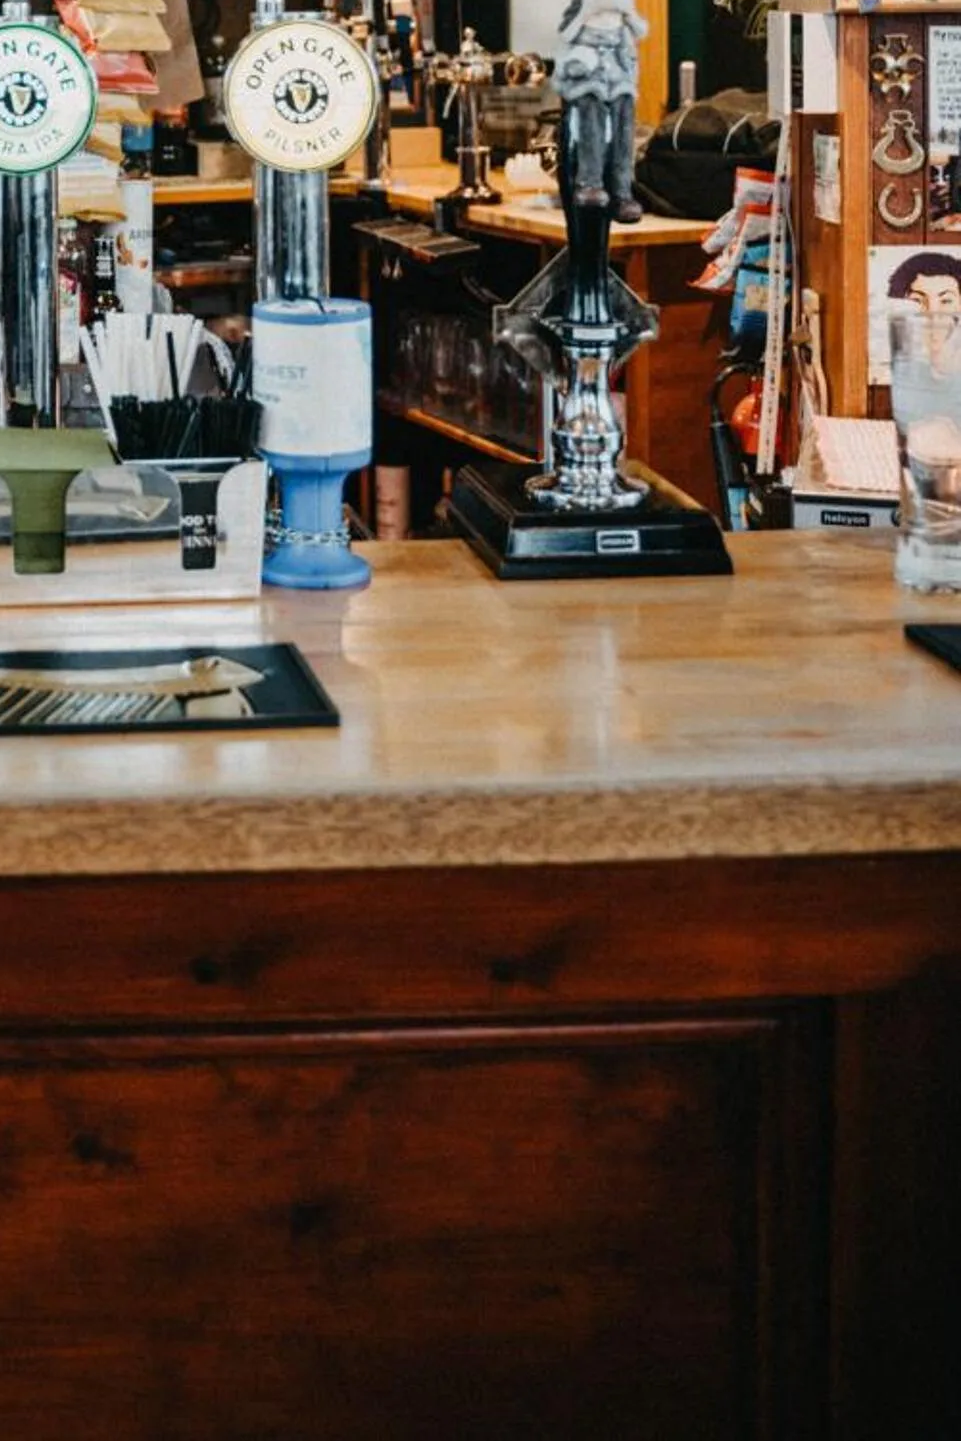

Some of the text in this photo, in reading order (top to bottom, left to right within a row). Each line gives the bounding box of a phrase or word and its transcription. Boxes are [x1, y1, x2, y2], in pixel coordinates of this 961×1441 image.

[26, 40, 77, 92] GATE
[246, 37, 356, 90] OPEN GATE
[35, 128, 65, 153] IPA
[263, 126, 343, 155] PILSNER
